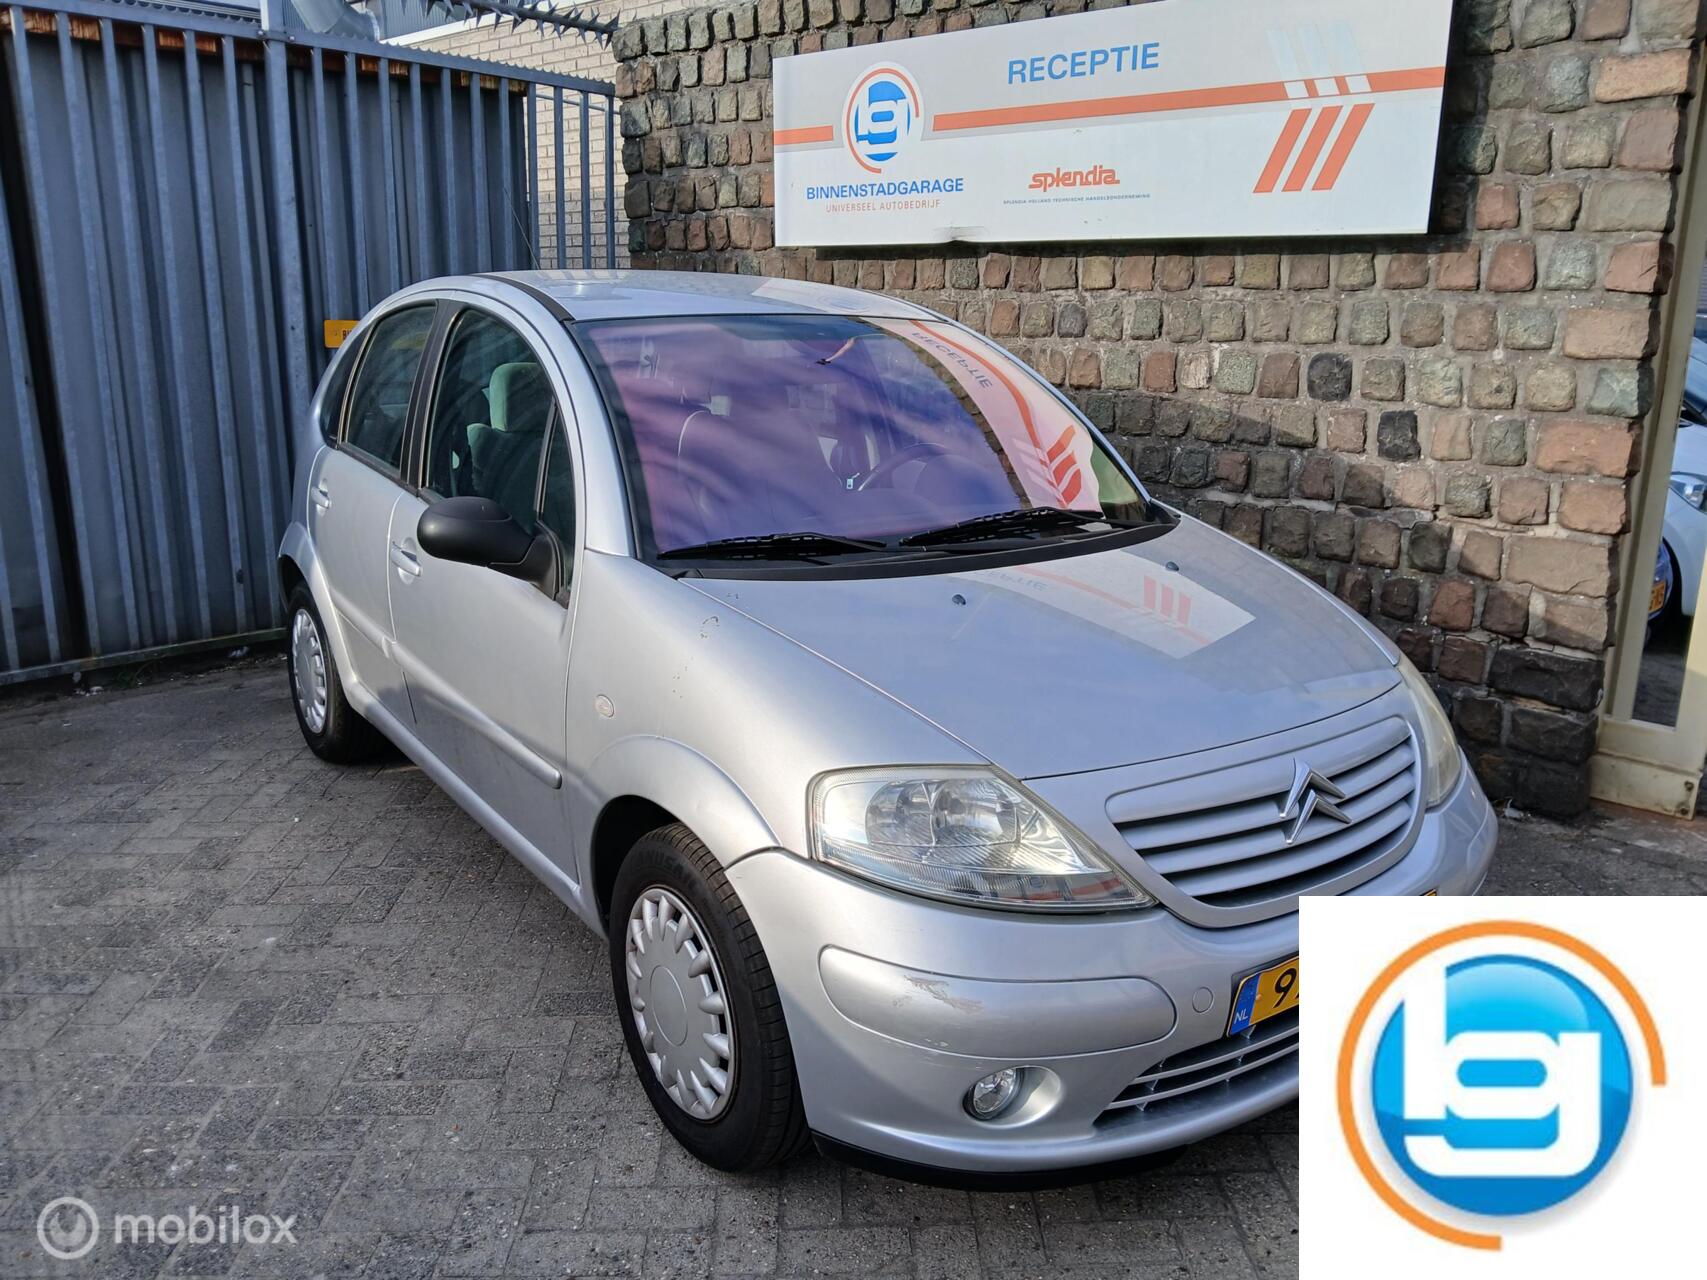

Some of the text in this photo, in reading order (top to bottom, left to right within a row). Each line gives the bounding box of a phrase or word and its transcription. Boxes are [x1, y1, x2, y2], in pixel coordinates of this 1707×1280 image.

[1008, 42, 1160, 84] RECEPTIE
[806, 178, 964, 200] BINNENSTADGARAGE
[1028, 164, 1121, 192] splendia
[826, 199, 941, 213] UNIVERSEEL AUTOBEDRIJF
[1234, 1008, 1248, 1024] NL
